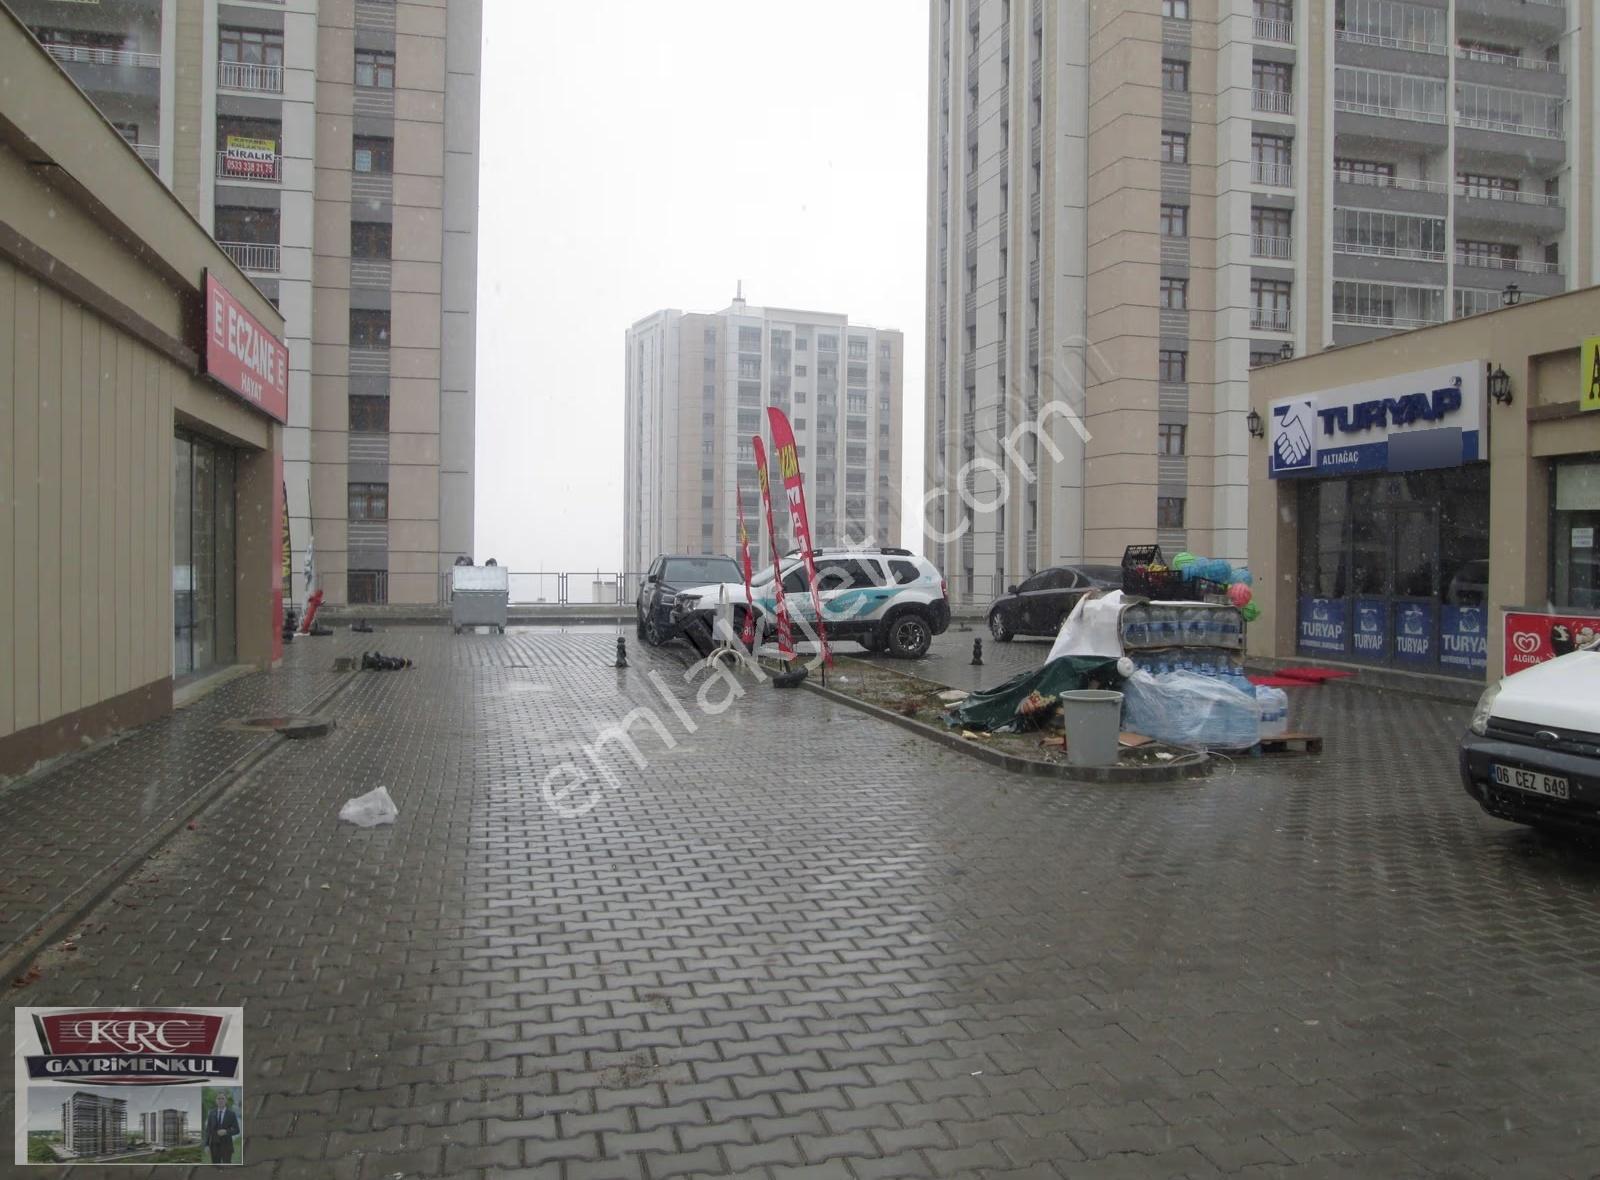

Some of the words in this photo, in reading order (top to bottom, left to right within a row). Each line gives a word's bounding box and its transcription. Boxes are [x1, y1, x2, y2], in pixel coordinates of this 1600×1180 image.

[228, 305, 274, 384] ECZANE
[241, 372, 263, 401] HAYAT
[1317, 387, 1462, 436] TURYAP
[1322, 450, 1359, 465] ALTIAĞAÇ
[1302, 622, 1342, 639] TURYAP
[1354, 633, 1383, 650] TURYAP
[1397, 636, 1429, 654] TURYAP
[1442, 634, 1487, 653] TURYA
[1513, 654, 1541, 664] ALGIDA
[1496, 767, 1509, 783] 06
[1516, 771, 1537, 790] CEZ
[1544, 777, 1566, 796] 649
